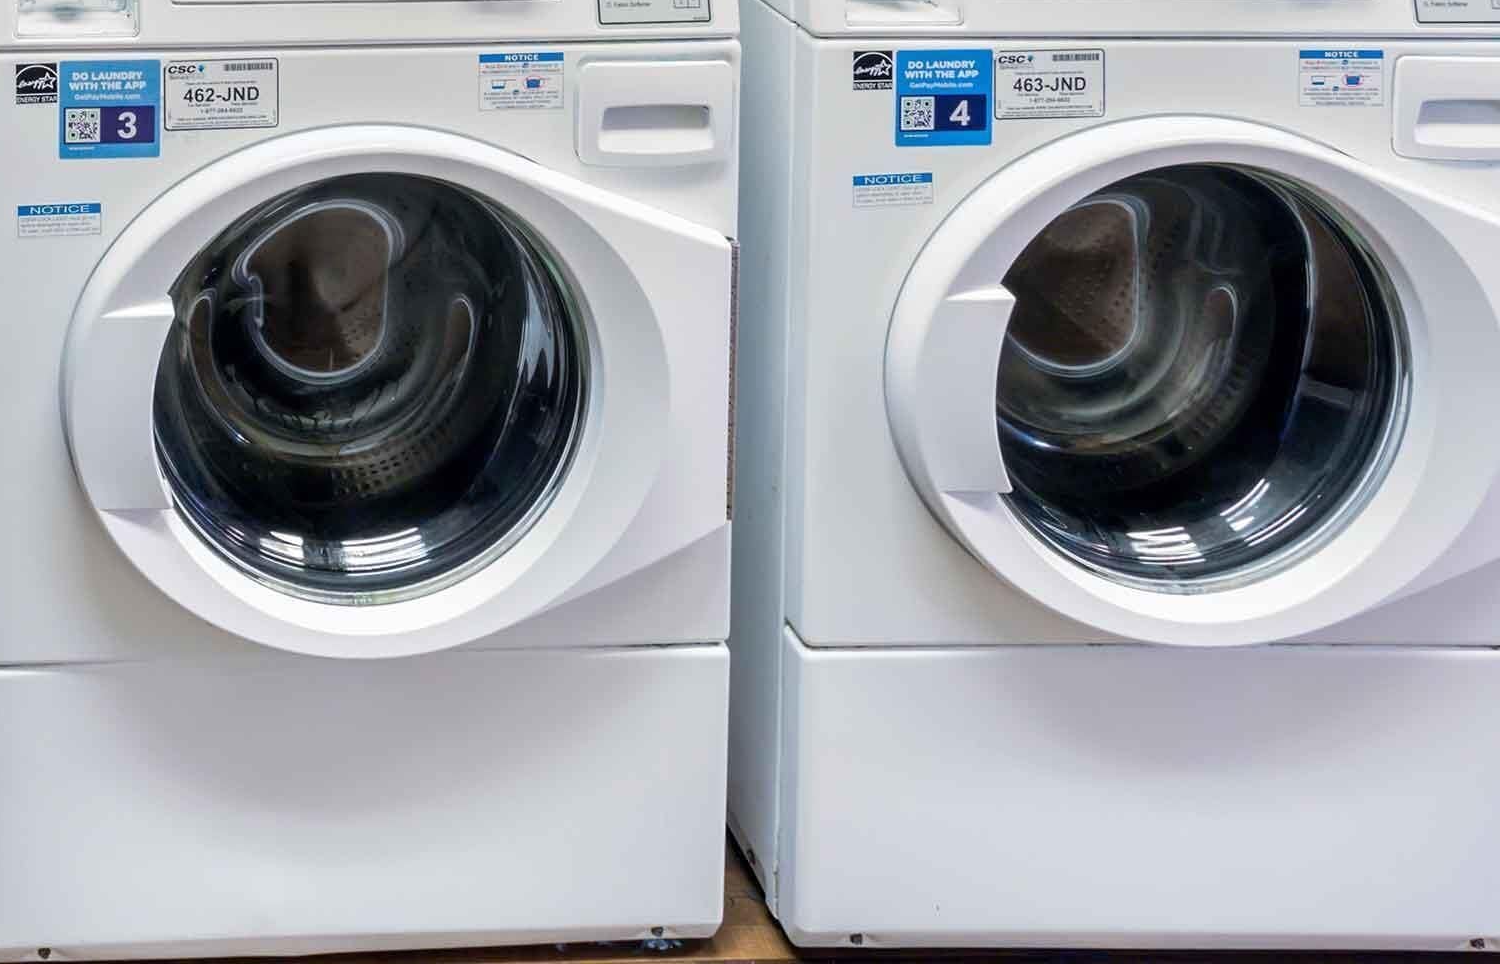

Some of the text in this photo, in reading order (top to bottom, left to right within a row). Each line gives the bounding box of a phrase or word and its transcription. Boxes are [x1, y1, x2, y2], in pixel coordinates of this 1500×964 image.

[908, 60, 976, 69] DO LAUNDRY
[998, 55, 1026, 64] CSC
[168, 65, 196, 74] CSC
[904, 70, 980, 79] WITH THE APP
[72, 71, 143, 81] DO LAUNDRY
[69, 81, 147, 91] WITH THE APP
[1013, 77, 1087, 92] 463-JND
[183, 86, 260, 103] 462-JND
[949, 99, 971, 126] 4
[117, 111, 137, 139] 3
[864, 175, 923, 184] NOTICE
[29, 204, 90, 214] NOTICE
